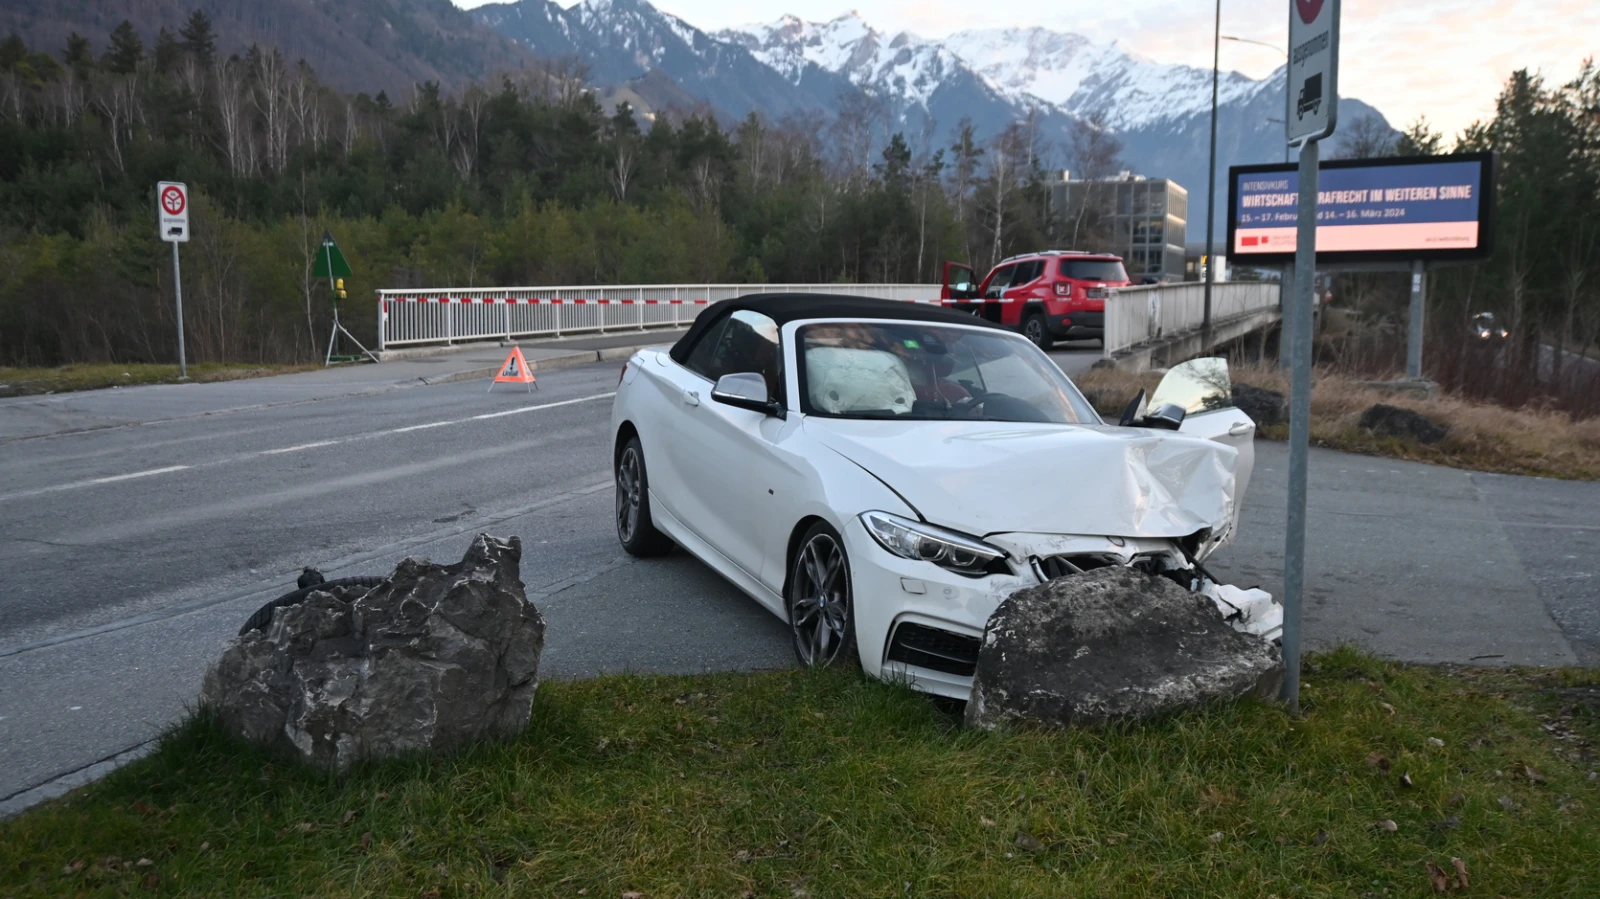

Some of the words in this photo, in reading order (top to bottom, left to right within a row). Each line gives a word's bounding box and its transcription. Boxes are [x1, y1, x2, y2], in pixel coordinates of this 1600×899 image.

[1243, 180, 1288, 191] INTENSIVKURS
[1370, 189, 1384, 202] IM
[1385, 186, 1437, 202] WEITEREN
[1439, 185, 1473, 199] SINNE
[1242, 213, 1254, 222] 15.
[1261, 212, 1273, 221] 17.
[1275, 212, 1298, 220] Febru
[1325, 210, 1337, 219] 14.
[1346, 209, 1358, 218] 16.
[1360, 209, 1382, 218] März
[1384, 208, 1405, 217] 2024
